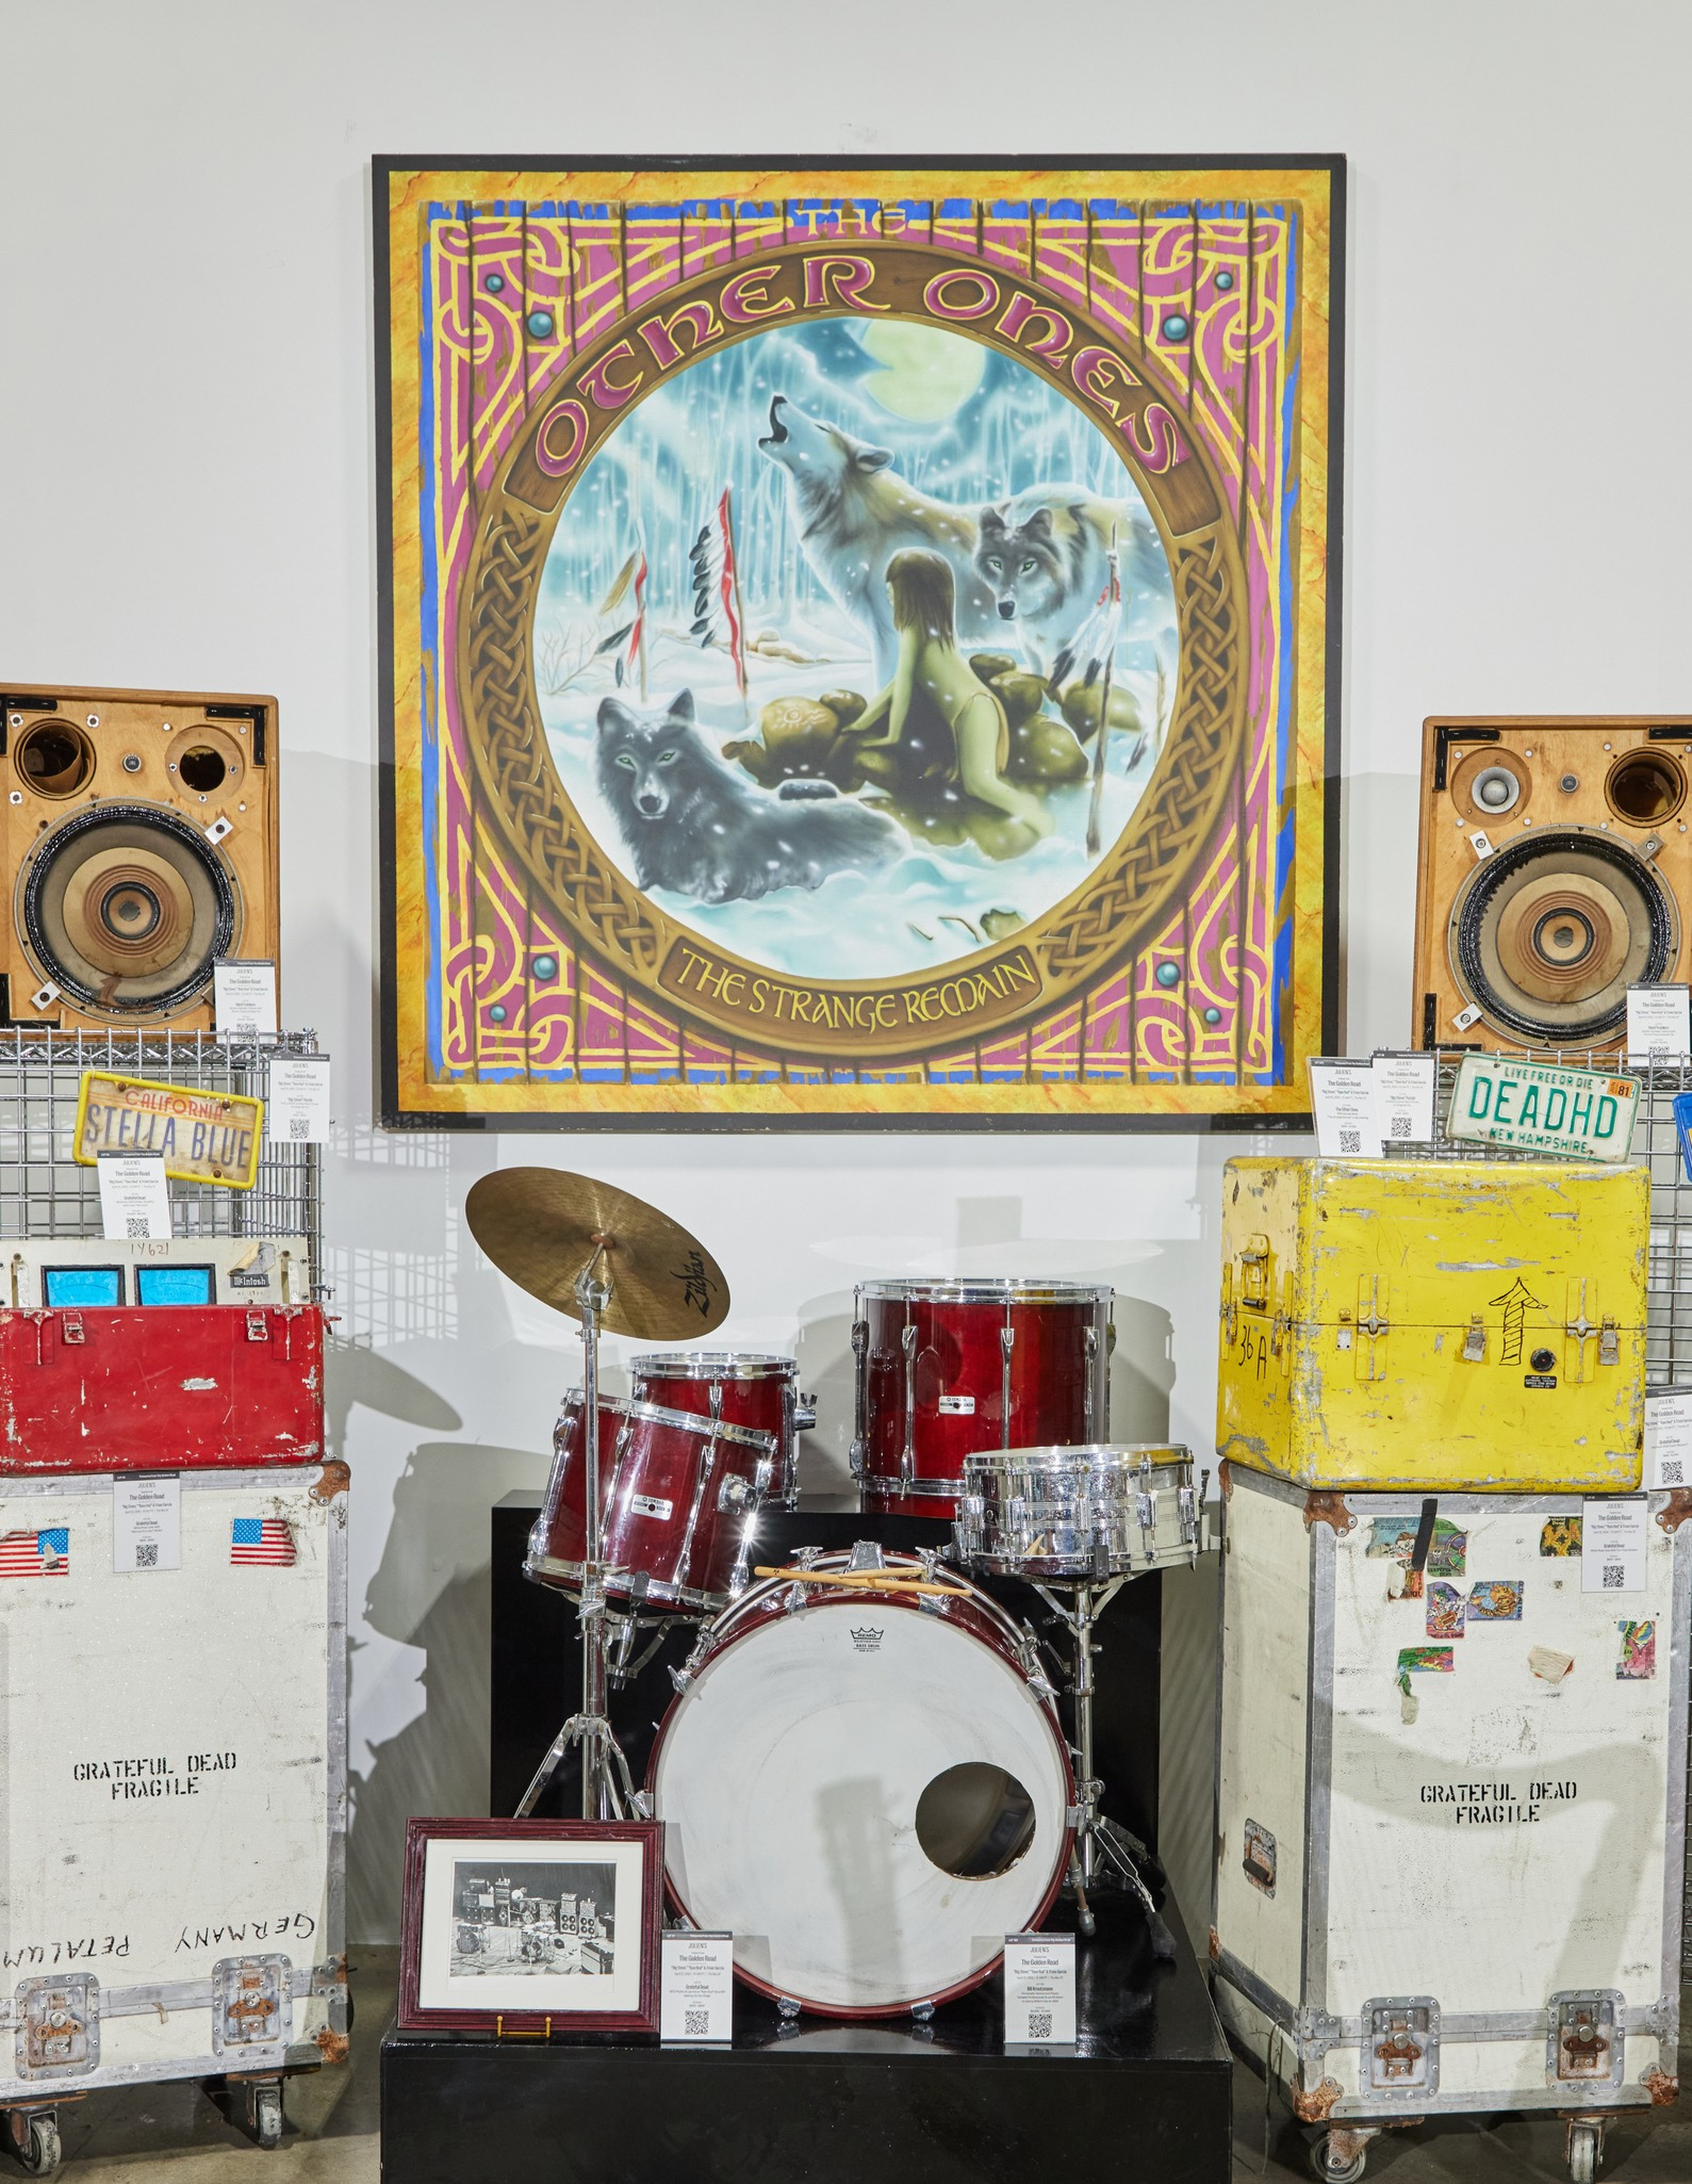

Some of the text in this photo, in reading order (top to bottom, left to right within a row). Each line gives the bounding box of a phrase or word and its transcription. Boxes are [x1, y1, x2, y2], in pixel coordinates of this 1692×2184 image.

[792, 208, 907, 236] THE
[923, 268, 1192, 474] ONES
[677, 948, 1036, 1034] THE STRANGE REMAIN
[1505, 1066, 1593, 1089] LIVE FREE OR DIE
[1618, 1085, 1629, 1096] 81
[126, 1091, 223, 1122] CALIFORNIA
[1469, 1076, 1618, 1138] DEADHD
[86, 1104, 250, 1168] STELLA BLUE
[1489, 1127, 1588, 1152] NEW HAMPSHIRE
[234, 1275, 266, 1286] McIntosh
[669, 1251, 717, 1318] Zildjian
[74, 1752, 236, 1780] GRATEFUL DEAD
[112, 1777, 199, 1800] FRAGILE
[1421, 1782, 1577, 1802] GRATEFUL DEAD
[1456, 1805, 1540, 1824] FRAGILE
[175, 1913, 315, 1953] GERMANY
